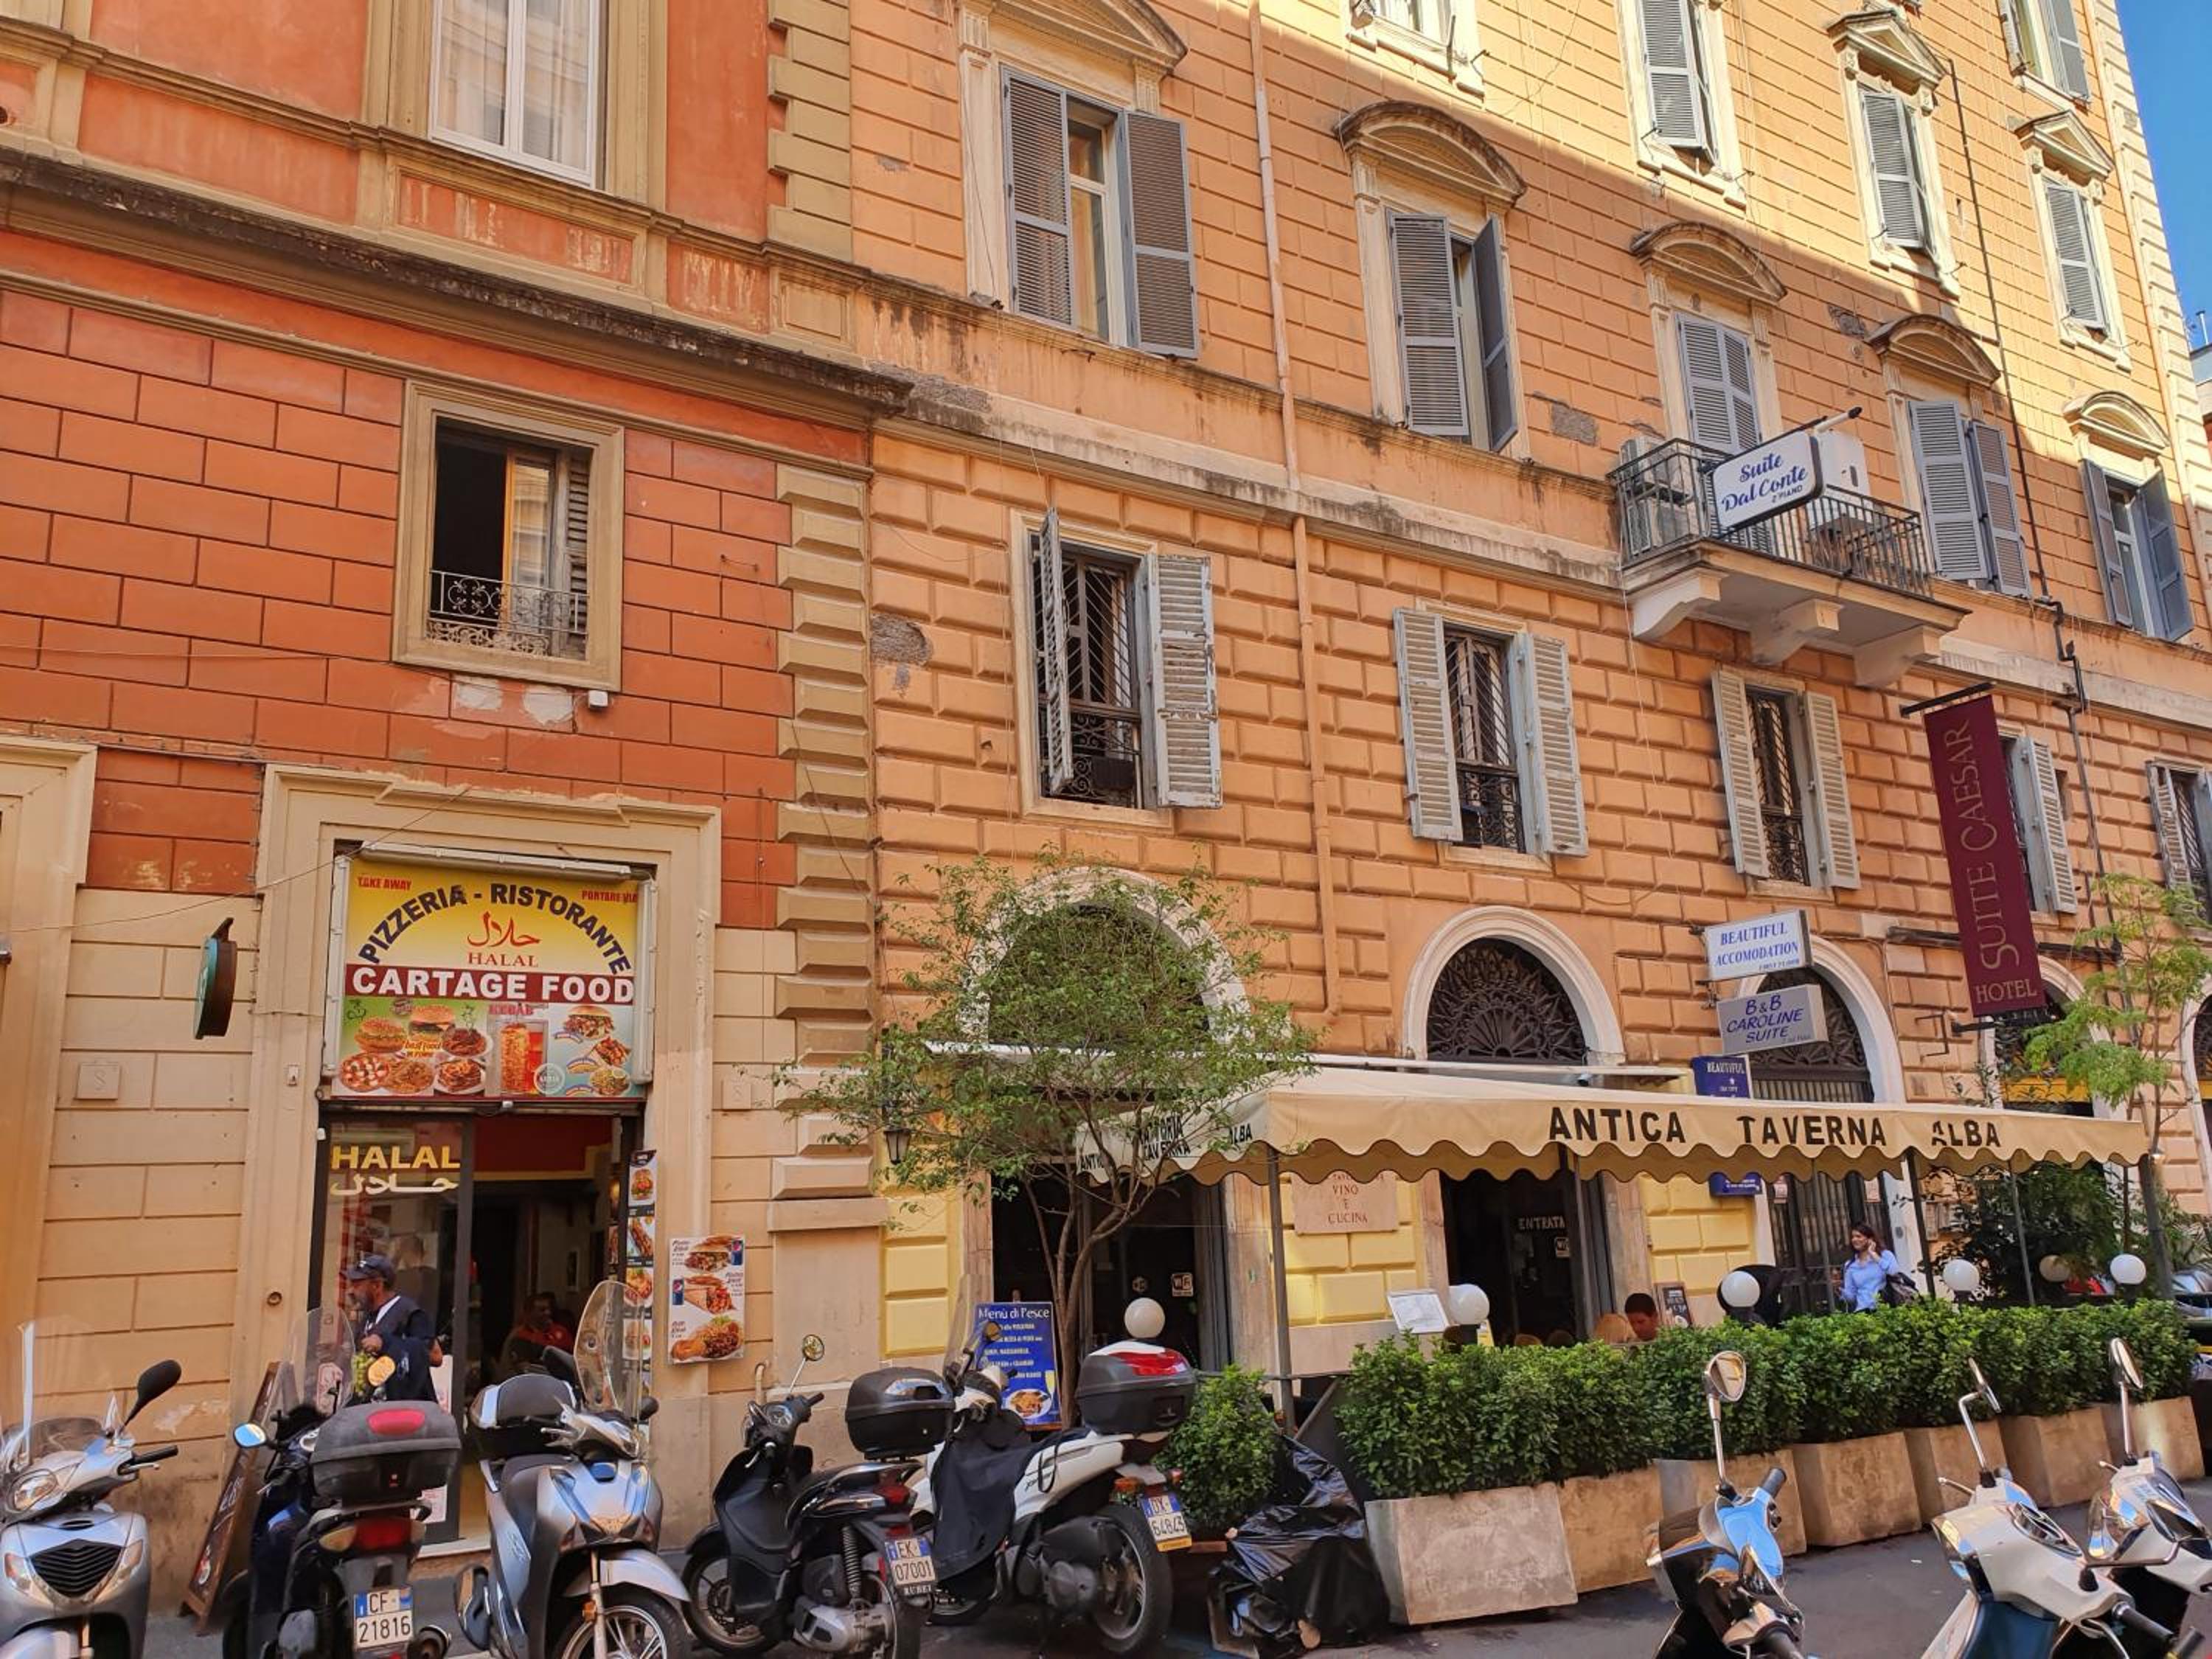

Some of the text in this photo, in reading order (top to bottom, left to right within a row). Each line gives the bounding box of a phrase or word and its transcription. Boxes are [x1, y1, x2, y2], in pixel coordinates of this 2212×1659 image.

[1740, 453, 1783, 482] Suite
[1722, 465, 1808, 512] Dal Conte
[1944, 719, 2020, 970] SUITE CAESAR
[358, 876, 412, 891] TAKE AWAY
[358, 884, 468, 964] PIZZERIA
[490, 883, 632, 975] RISTORANTE
[467, 911, 541, 947] حلال
[1721, 922, 1788, 945] BEAUTIFUL
[468, 952, 539, 967] HALAL
[1715, 941, 1799, 967] ACCOMODATION
[352, 967, 634, 1003] CARTAGE FOOD
[1974, 978, 2037, 1004] HOTEL
[1726, 1008, 1804, 1033] CAROLINE
[1745, 1026, 1790, 1043] SUITE
[1706, 1062, 1745, 1074] BEAUTIFUL
[1547, 1107, 2002, 1148] ANTICA TAVERNA ALBA
[331, 1144, 461, 1169] HALAL
[1332, 1183, 1360, 1195] VINO
[1328, 1211, 1368, 1224] CUCINA
[1518, 1216, 1565, 1230] ENTRATA
[896, 1540, 915, 1558] EK
[894, 1559, 933, 1581] 07001
[369, 1591, 389, 1614] CF
[358, 1615, 411, 1644] 21816
